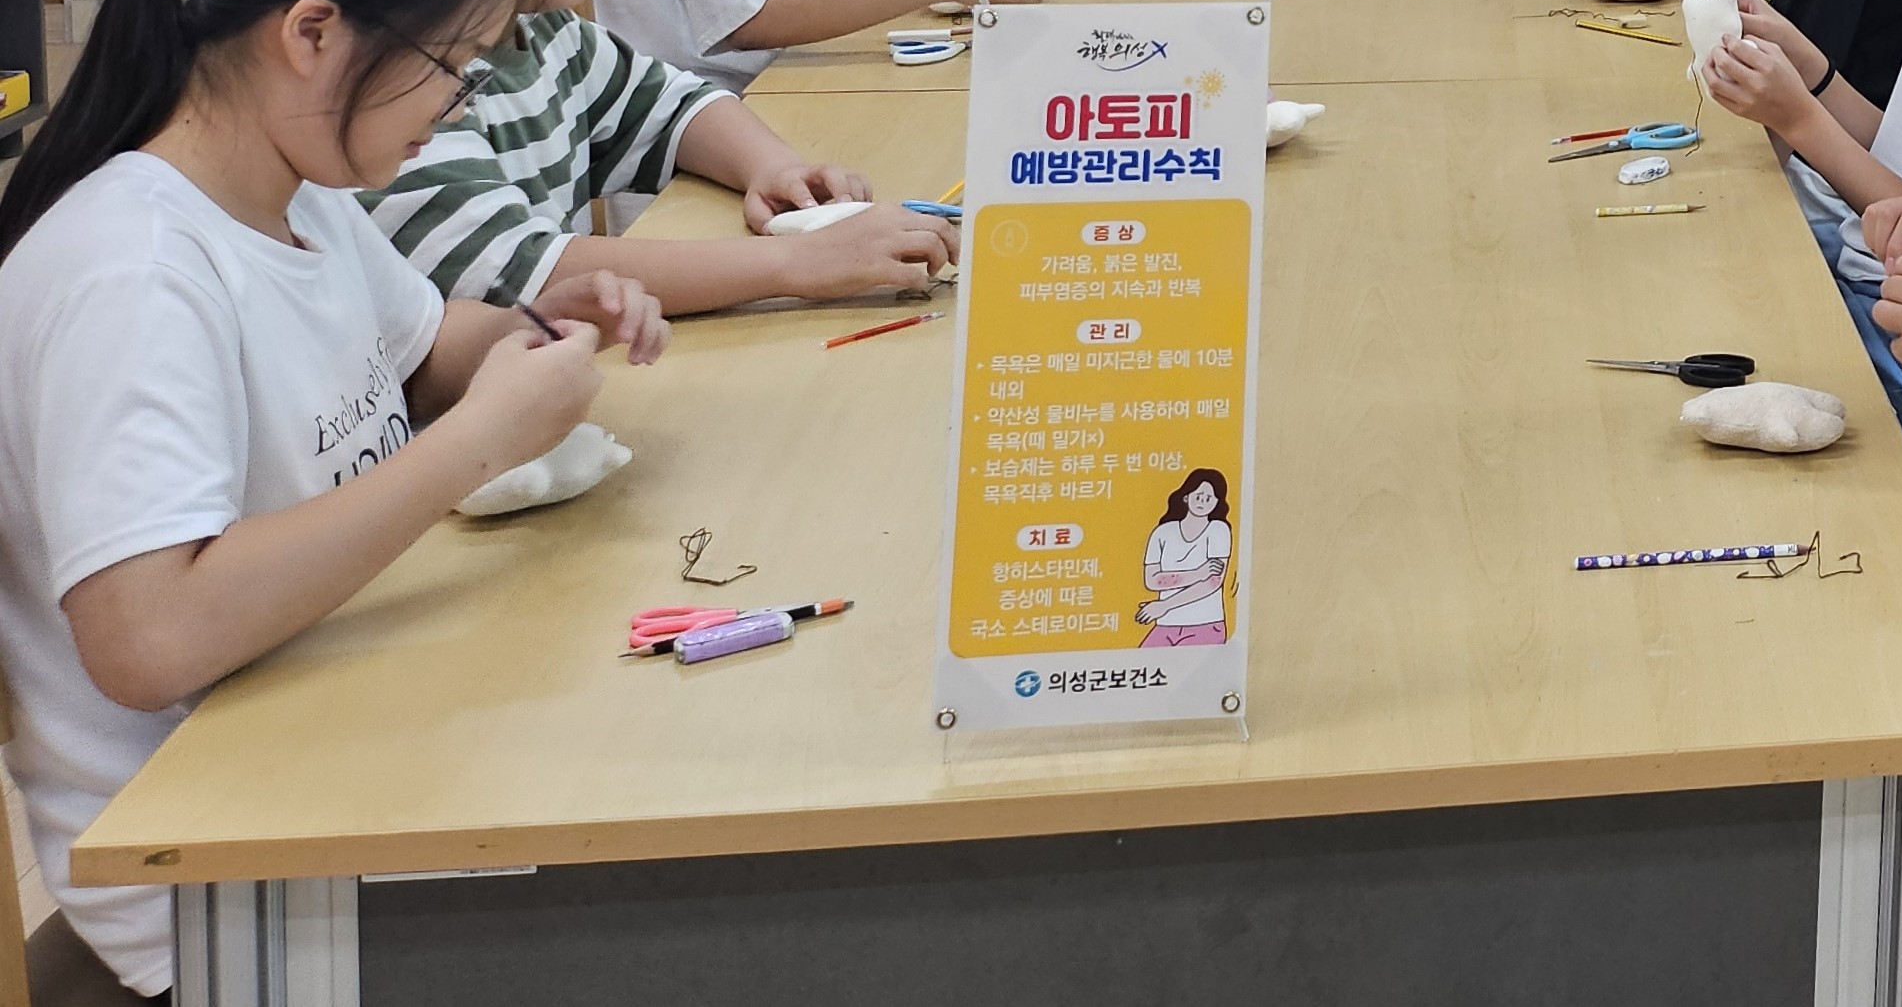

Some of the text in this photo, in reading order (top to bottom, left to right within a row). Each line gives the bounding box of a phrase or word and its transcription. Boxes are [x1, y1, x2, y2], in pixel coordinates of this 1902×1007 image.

[1045, 92, 1192, 141] 아토피
[1010, 147, 1222, 185] 예방관리수칙
[1041, 251, 1183, 275] 가려움, 붉은 발진,
[1020, 277, 1202, 302] 피부염증의 지속과 반복
[990, 347, 1233, 374] 목욕은 매일 미지근한 물에 10분
[990, 379, 1025, 401] 내외
[987, 397, 1231, 426] 약산성 물비누를 사용하여 매일
[986, 430, 1046, 452] 목욕(때
[983, 450, 1188, 478] 보습제는 하루 두 번 이상,
[983, 479, 1113, 504] 목욕직후 바르기
[992, 557, 1104, 583] 항히스타민제,
[999, 585, 1094, 611] 증상에 따른
[970, 612, 1120, 641] 국소 스테로이드제
[1048, 666, 1169, 693] 의성군보건소
